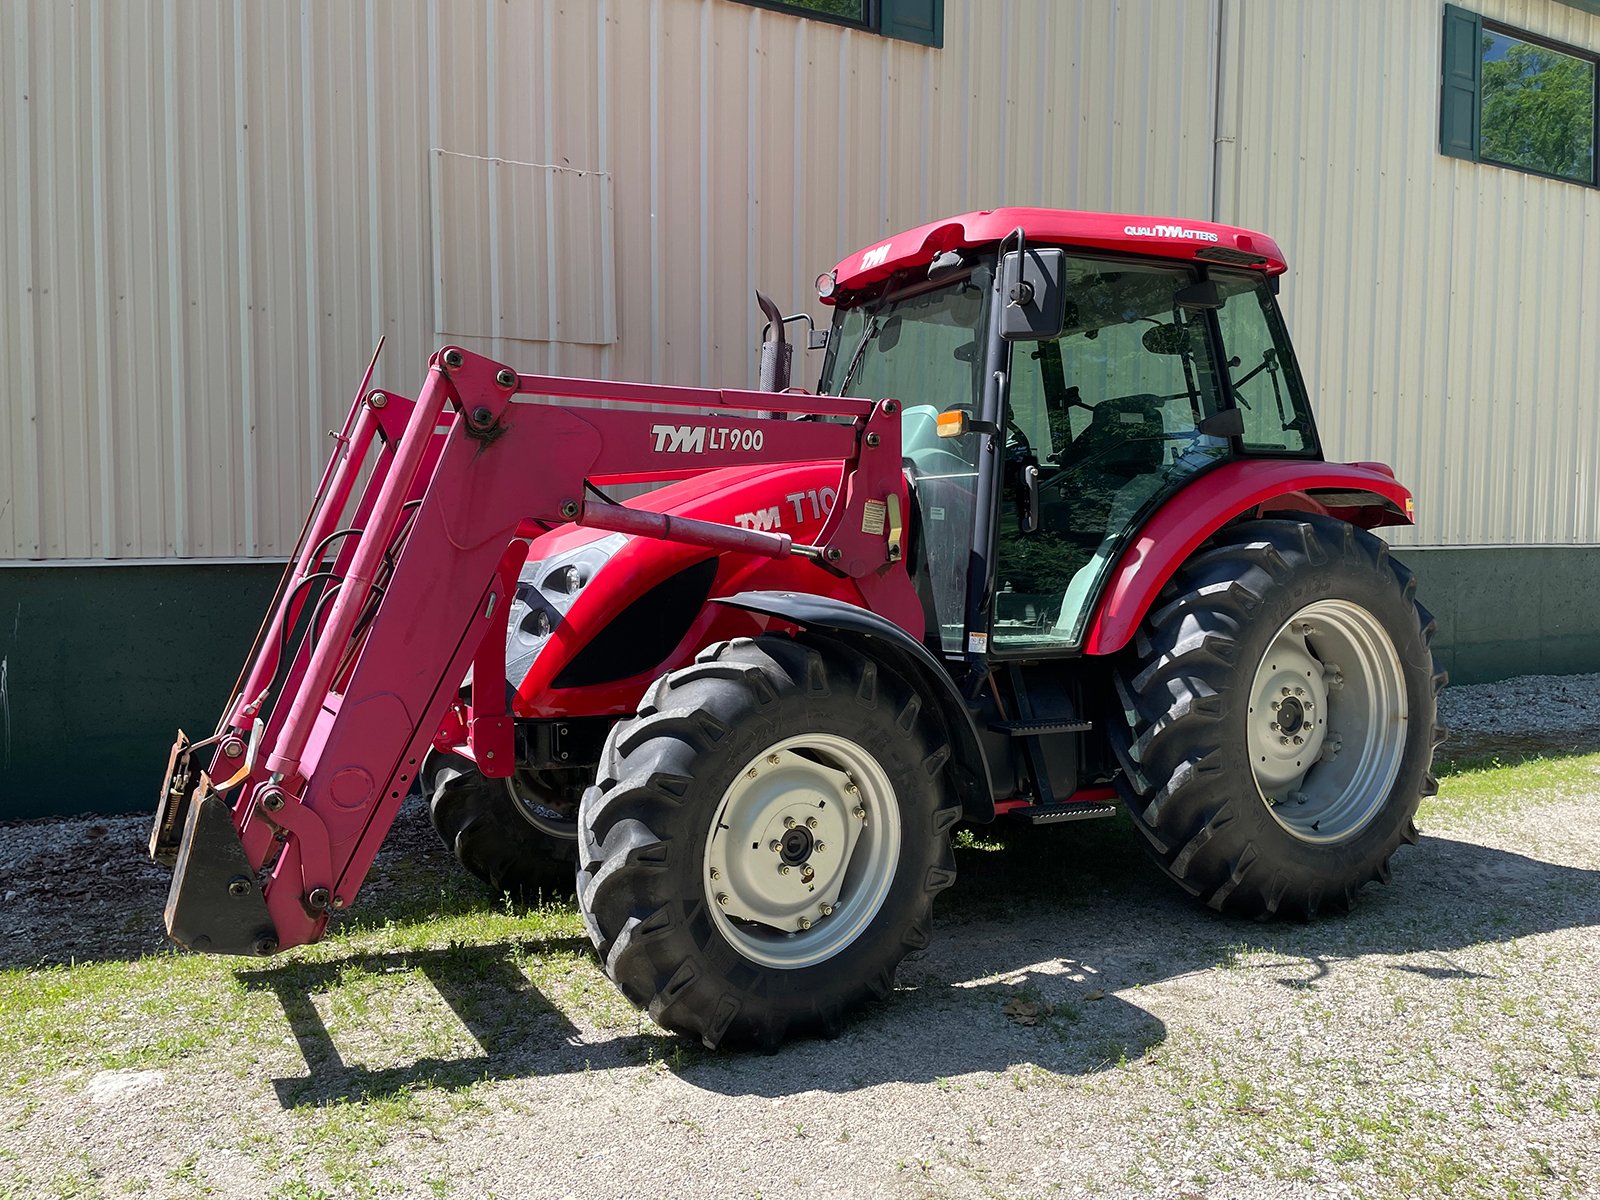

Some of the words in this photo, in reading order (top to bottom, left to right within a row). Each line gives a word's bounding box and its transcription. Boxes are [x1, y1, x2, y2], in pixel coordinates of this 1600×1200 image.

[860, 243, 892, 270] TYM
[651, 424, 706, 453] TYM
[709, 427, 764, 451] LT900
[734, 506, 781, 531] TYM
